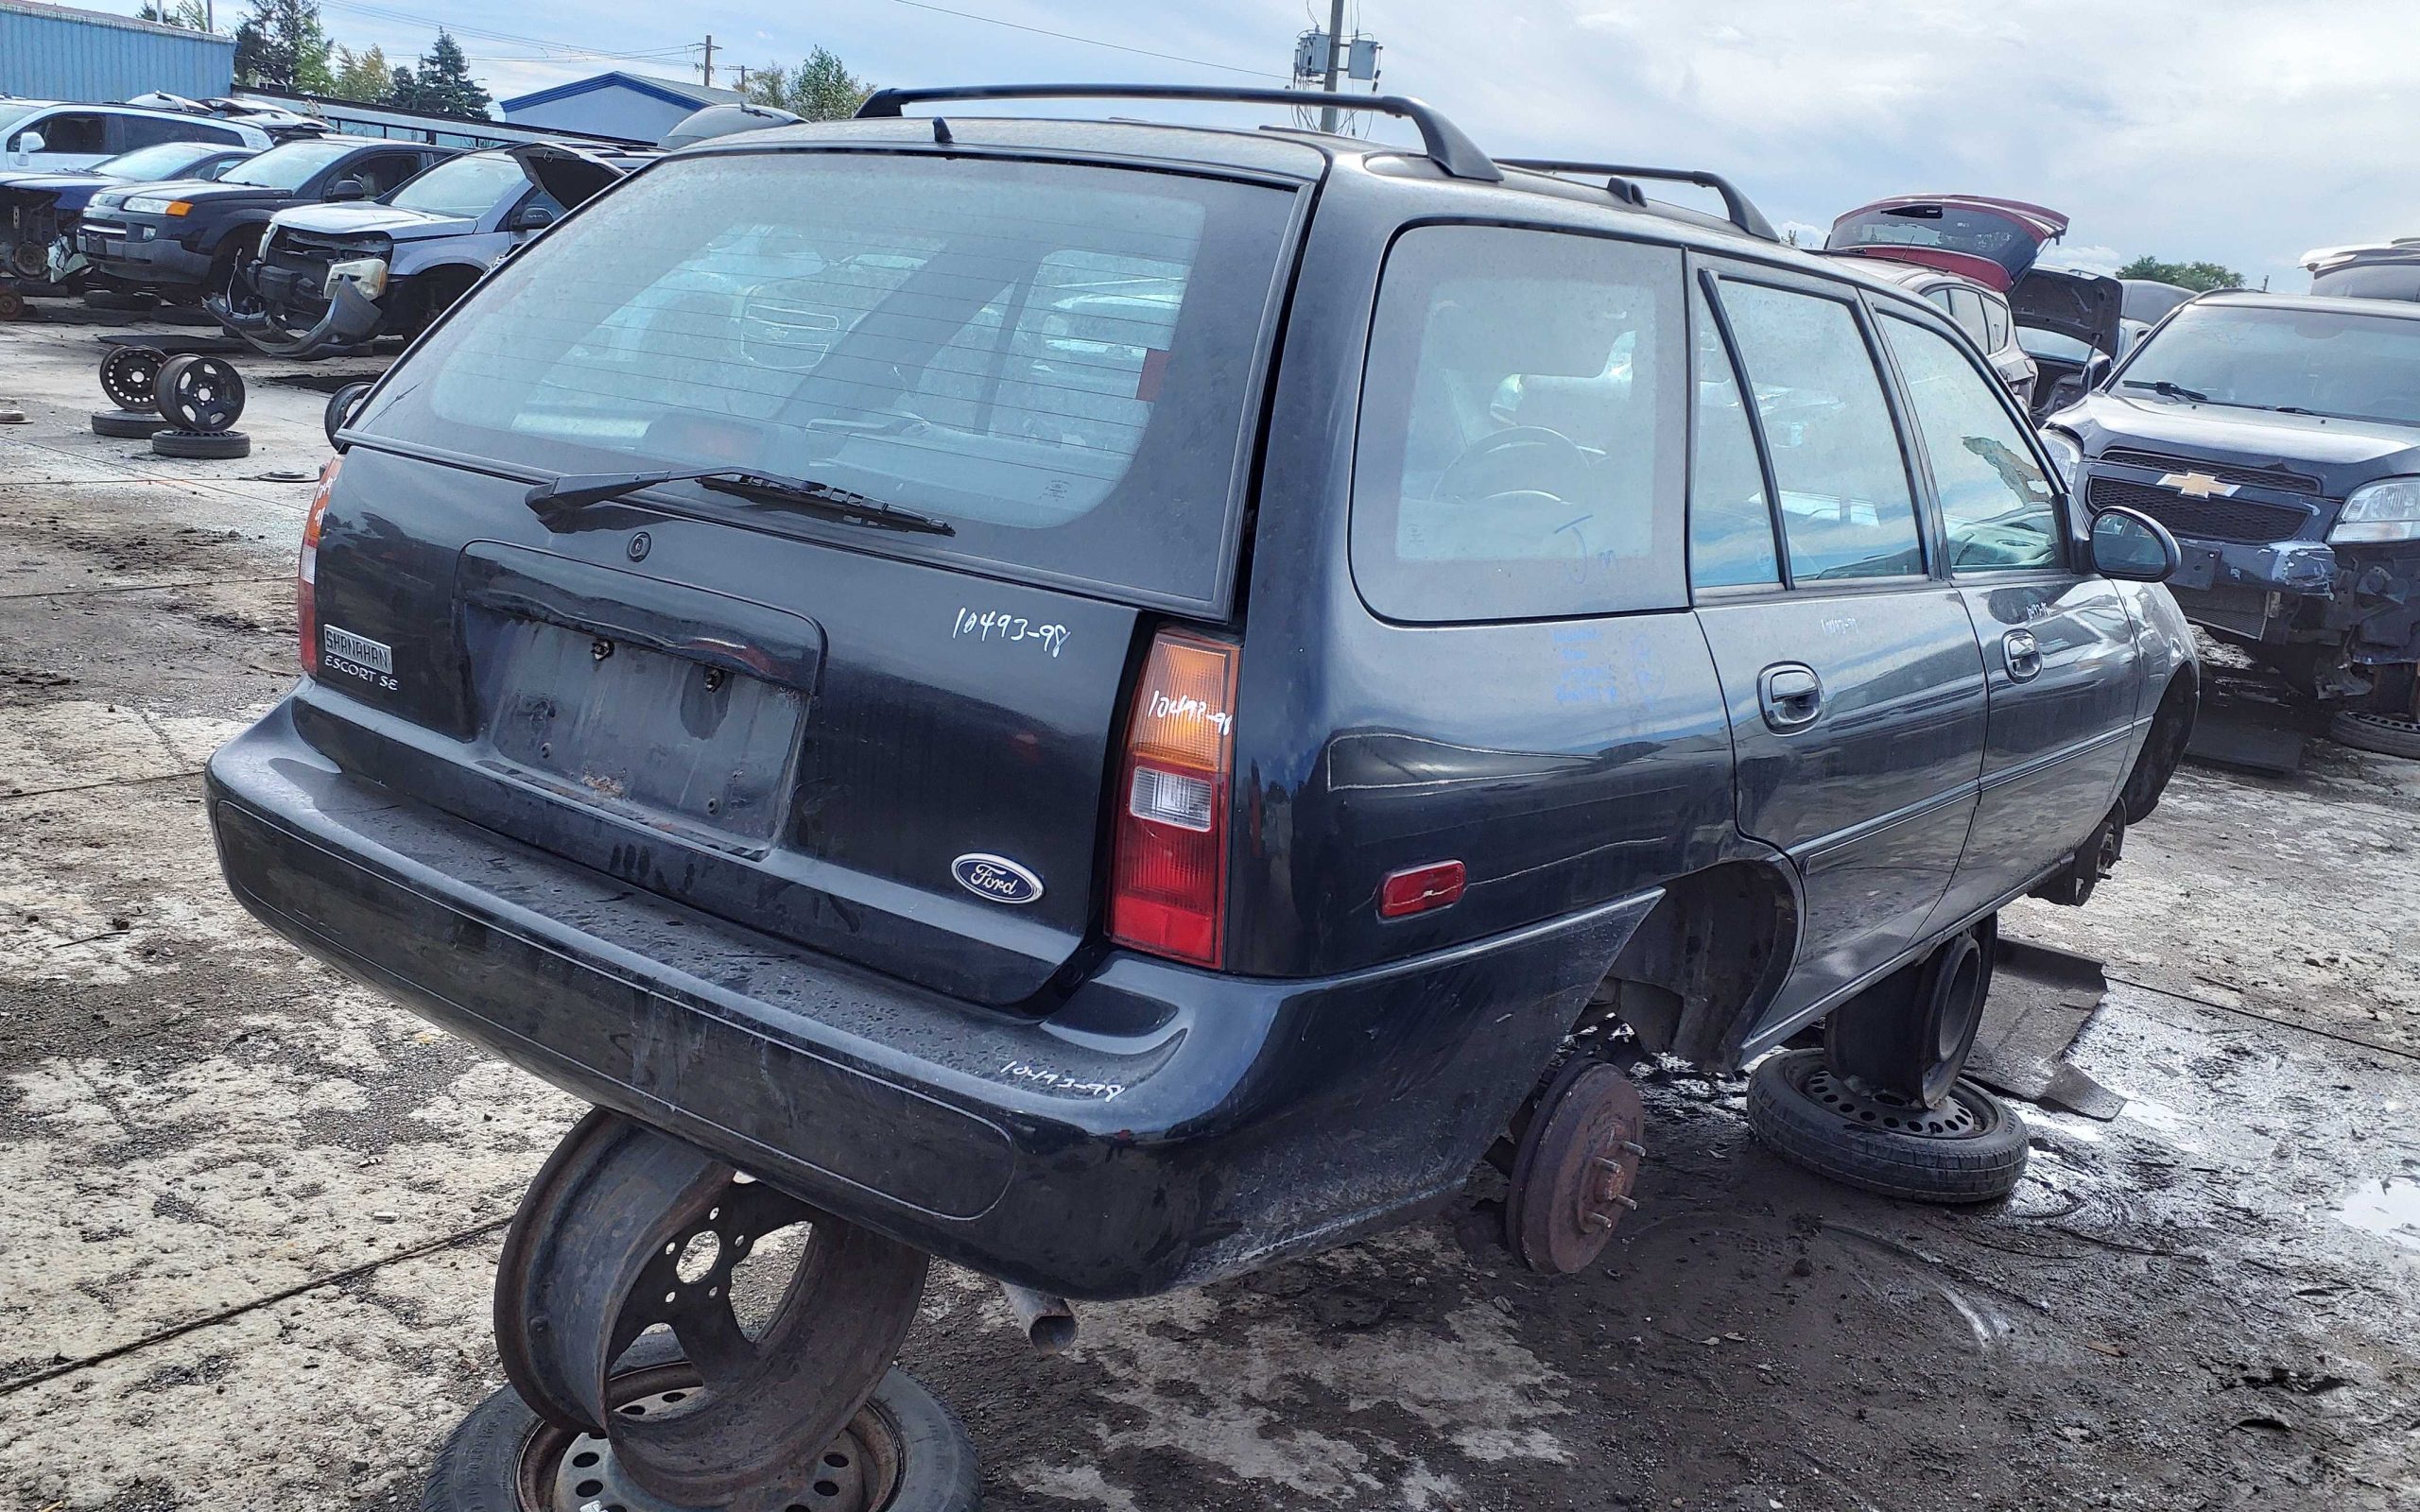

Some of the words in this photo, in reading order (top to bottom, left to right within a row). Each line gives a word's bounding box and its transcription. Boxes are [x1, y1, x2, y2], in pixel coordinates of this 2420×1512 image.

[326, 630, 388, 668] SHANAHAN
[953, 607, 1071, 658] 10493-98
[325, 656, 376, 682] ESCORT
[379, 675, 398, 691] SE
[971, 864, 1018, 895] Ford
[1000, 1060, 1126, 1103] 10493-98
